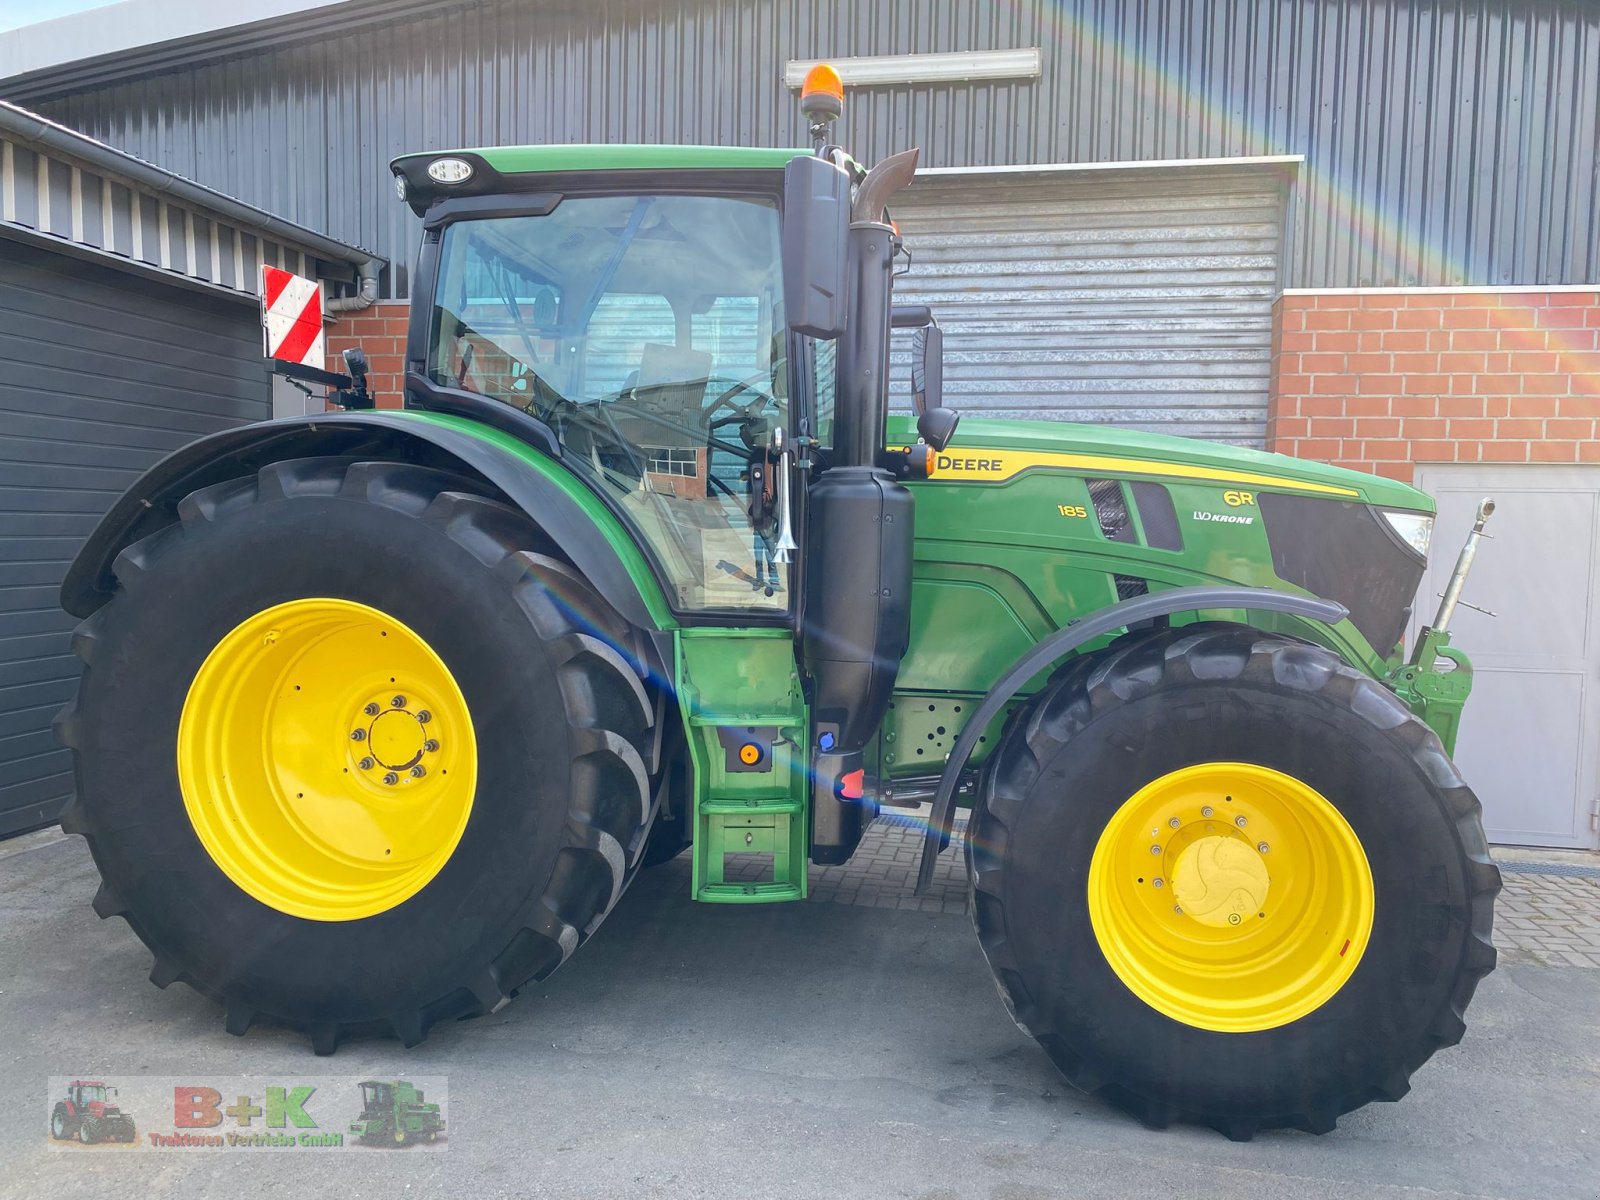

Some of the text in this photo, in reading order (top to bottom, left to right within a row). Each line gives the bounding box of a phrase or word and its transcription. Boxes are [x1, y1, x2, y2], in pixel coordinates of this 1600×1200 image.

[937, 455, 1003, 472] DEERE
[1223, 490, 1255, 507] 6R
[1057, 504, 1088, 518] 185
[1211, 514, 1254, 525] KRONE
